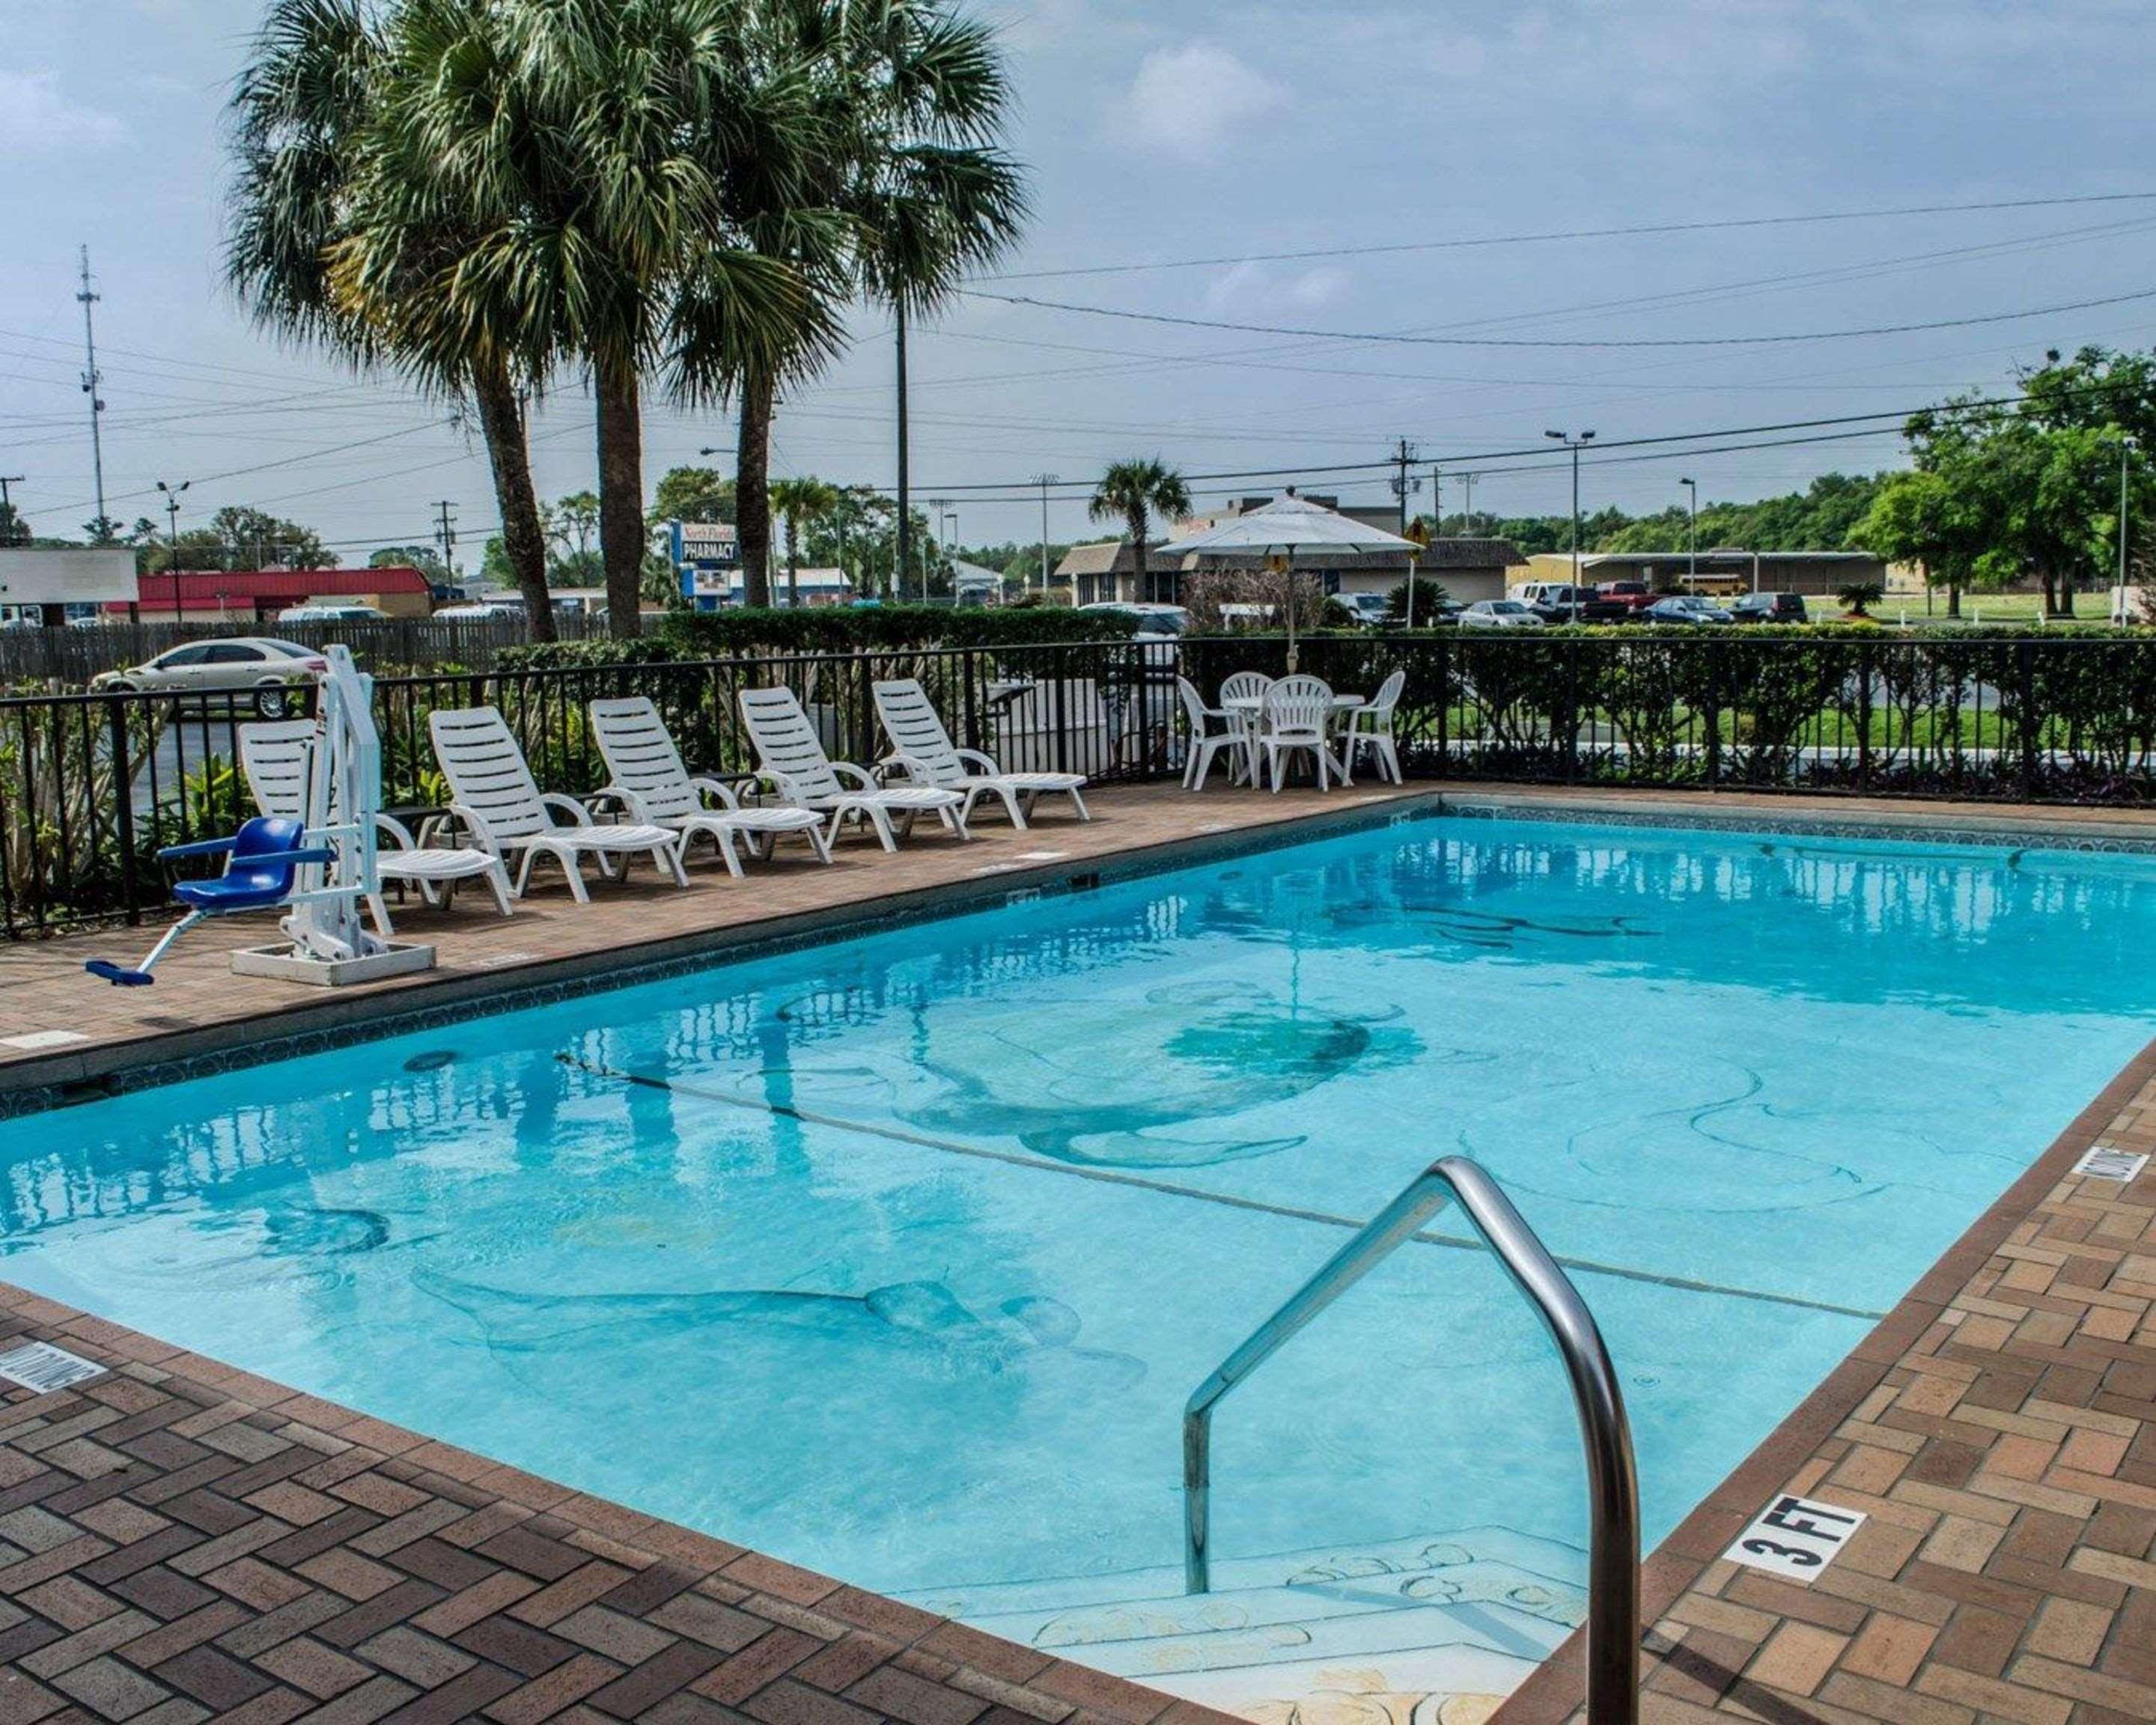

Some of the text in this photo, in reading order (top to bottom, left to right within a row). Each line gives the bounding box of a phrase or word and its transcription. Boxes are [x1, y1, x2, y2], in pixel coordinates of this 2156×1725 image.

[684, 542, 734, 559] PHARMACY
[1742, 1497, 1856, 1566] 3 FT
